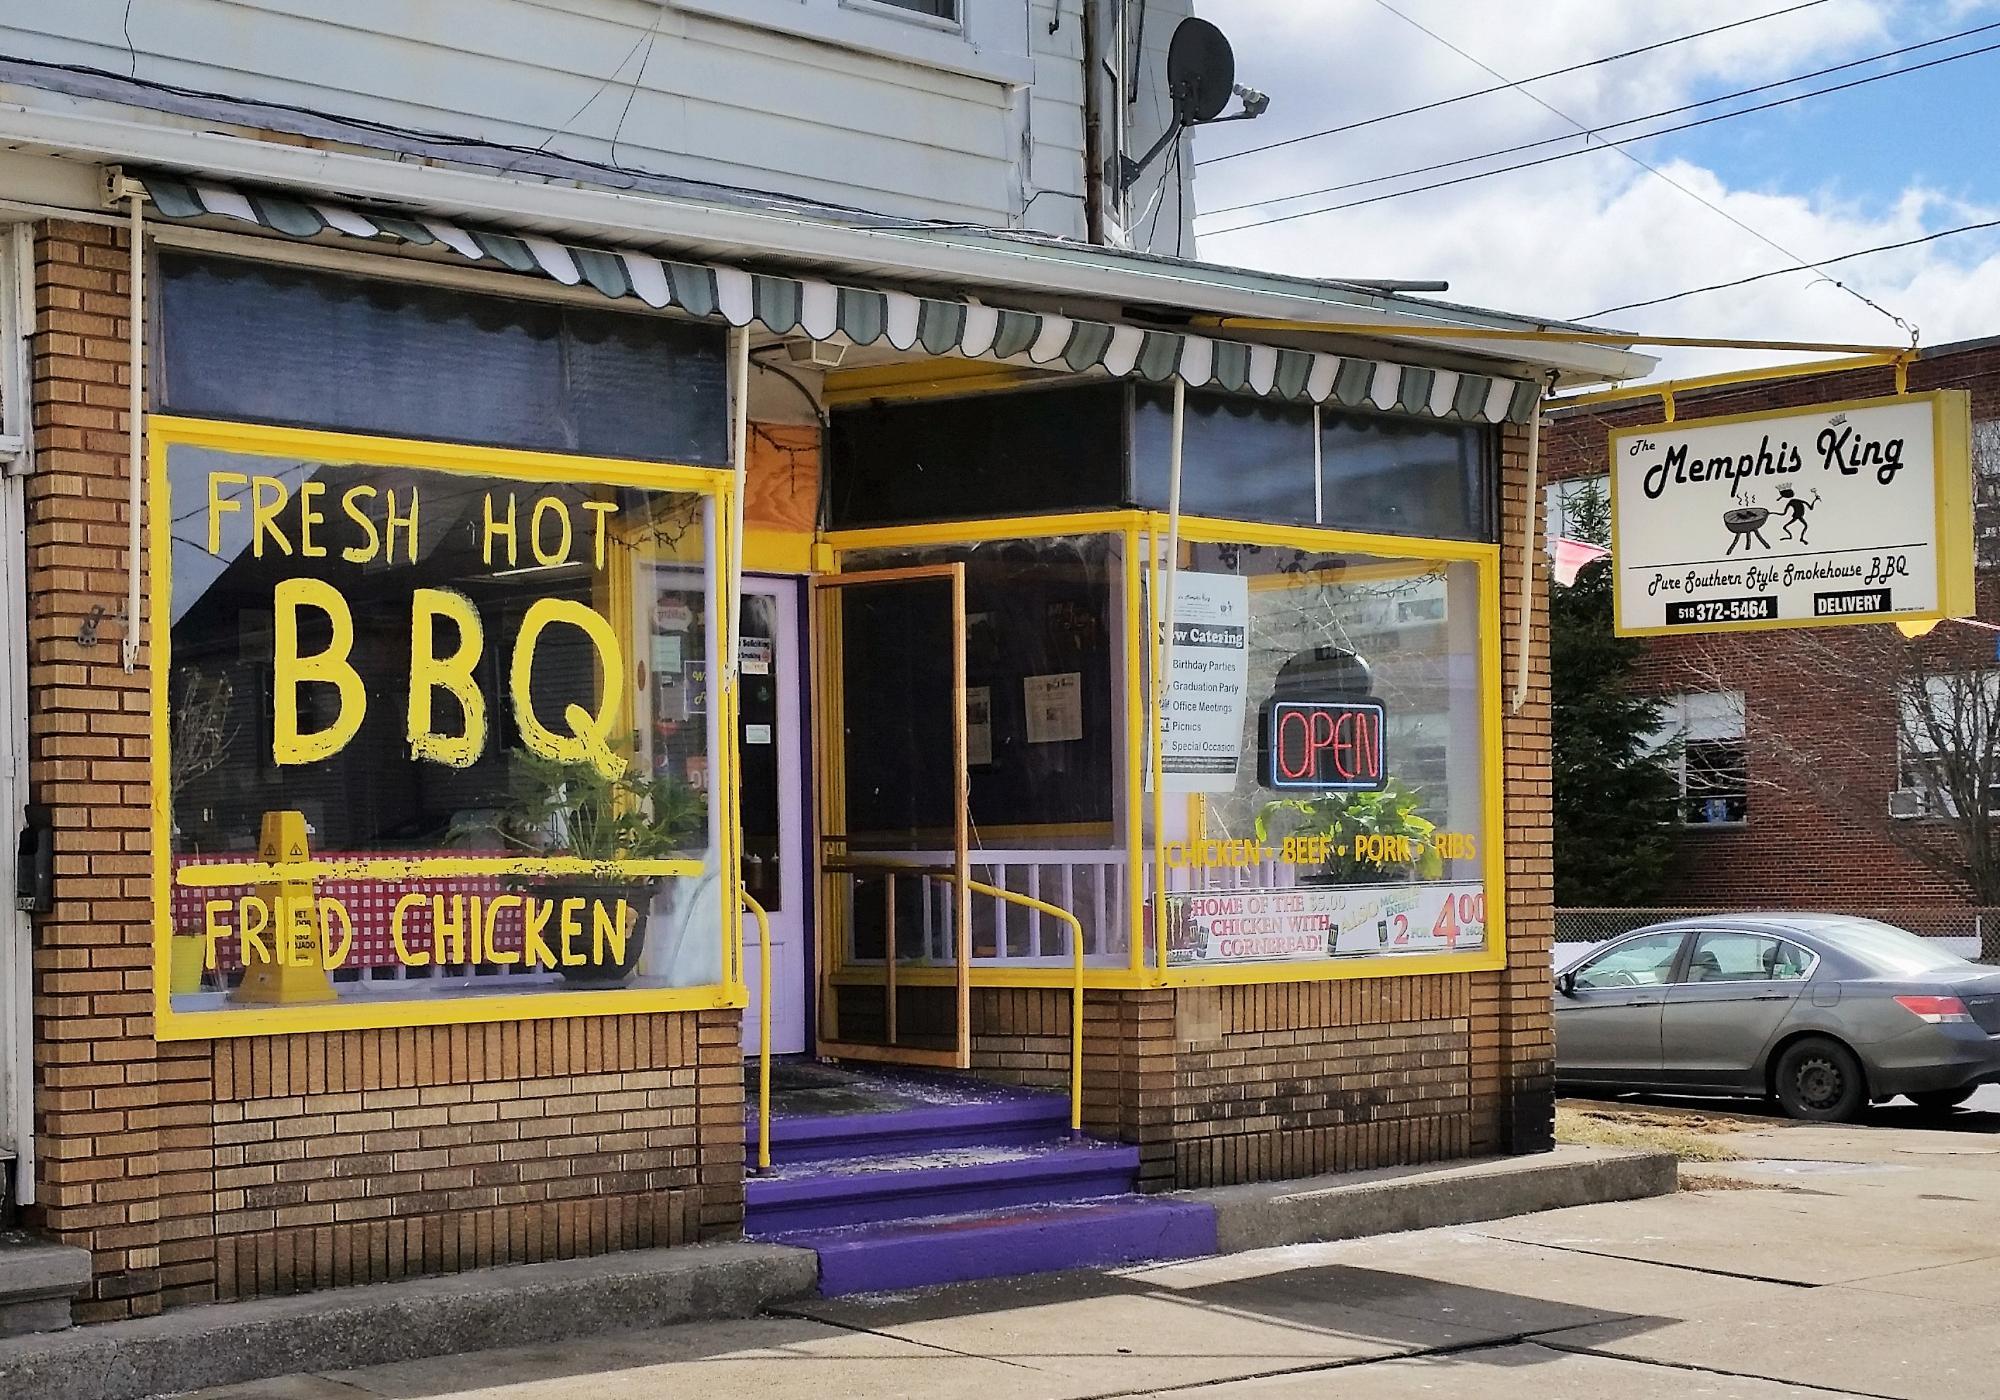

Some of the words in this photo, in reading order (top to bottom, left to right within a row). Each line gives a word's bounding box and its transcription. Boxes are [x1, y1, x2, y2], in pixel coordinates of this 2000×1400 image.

[1630, 439, 1656, 456] The
[1643, 434, 1802, 499] Memphis
[1816, 426, 1904, 485] King
[207, 471, 419, 566] FRESH
[482, 491, 620, 571] HOT
[1648, 573, 1681, 596] Pure
[1685, 569, 1742, 593] Southern
[1746, 565, 1779, 592] Style
[1783, 560, 1862, 587] Smokehouse
[1864, 555, 1909, 585] BBQ
[1678, 607, 1695, 619] 518
[1696, 600, 1768, 621] 372-5464
[1818, 594, 1882, 614] DELIVERY
[1189, 628, 1243, 648] Catering
[1172, 659, 1207, 672] Birthday
[1208, 660, 1237, 672] Parties
[272, 577, 629, 780] BBQ
[1173, 680, 1218, 692] Graduation
[1219, 682, 1239, 695] Party
[1172, 700, 1197, 711] Office
[1198, 701, 1233, 714] Meetings
[1172, 721, 1201, 732] Picnics
[1171, 741, 1202, 752] Special
[1202, 741, 1235, 752] Occasion
[1279, 711, 1379, 778] OPEN
[1165, 839, 1260, 869] CHICKEN
[1283, 836, 1331, 864] BEEF
[1355, 833, 1412, 862] PORK
[1434, 831, 1477, 861] RIBS
[1193, 898, 1243, 917] HOME
[1247, 898, 1270, 914] OF
[1273, 895, 1305, 913] THE
[205, 895, 353, 971] FRIED
[392, 893, 628, 970] CHICKEN
[1210, 917, 1282, 936] CHICKEN
[1288, 914, 1330, 933] WITH
[1393, 914, 1410, 945] 2
[1220, 934, 1323, 957] CORNBREAD!
